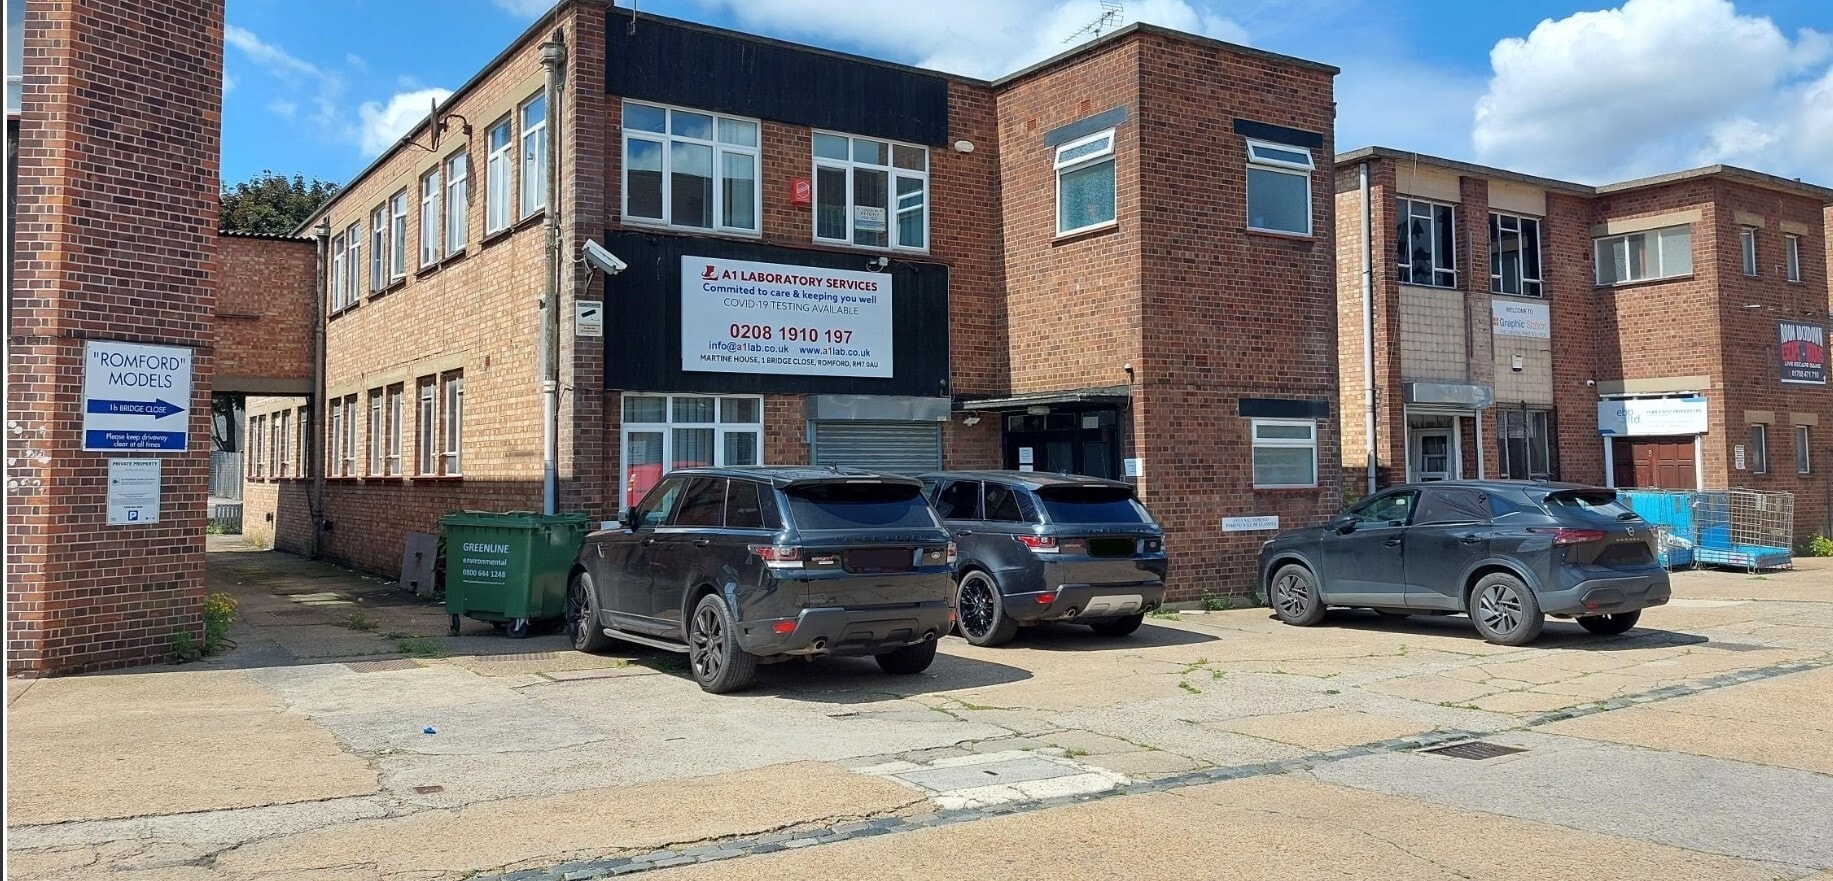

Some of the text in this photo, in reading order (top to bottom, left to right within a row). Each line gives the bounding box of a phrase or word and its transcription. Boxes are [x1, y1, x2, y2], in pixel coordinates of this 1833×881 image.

[722, 269, 878, 291] A1 LABORATORY SERVICES
[703, 283, 877, 304] Commited to care & keeping you well
[724, 298, 859, 315] COVID-19 TESTING AVAILABLE
[1500, 318, 1525, 329] Graphic
[730, 323, 853, 344] 0208 1910 197
[708, 341, 871, 357] info@a1lab.co.uk www.a1lab.co.uk
[93, 352, 186, 371] "ROMFORD"
[700, 354, 733, 363] MARTINE
[733, 355, 760, 364] HOUSE,
[766, 357, 792, 365] BRIDGE
[792, 358, 817, 367] CLOSE,
[817, 359, 851, 368] ROMFORD,
[108, 372, 172, 388] MODELS
[110, 403, 167, 413] 1b BRIDGE CLOSE
[105, 432, 168, 442] Please keep driveway
[463, 543, 510, 554] GREENLINE
[462, 557, 507, 566] environmental
[490, 570, 506, 578] 1248
